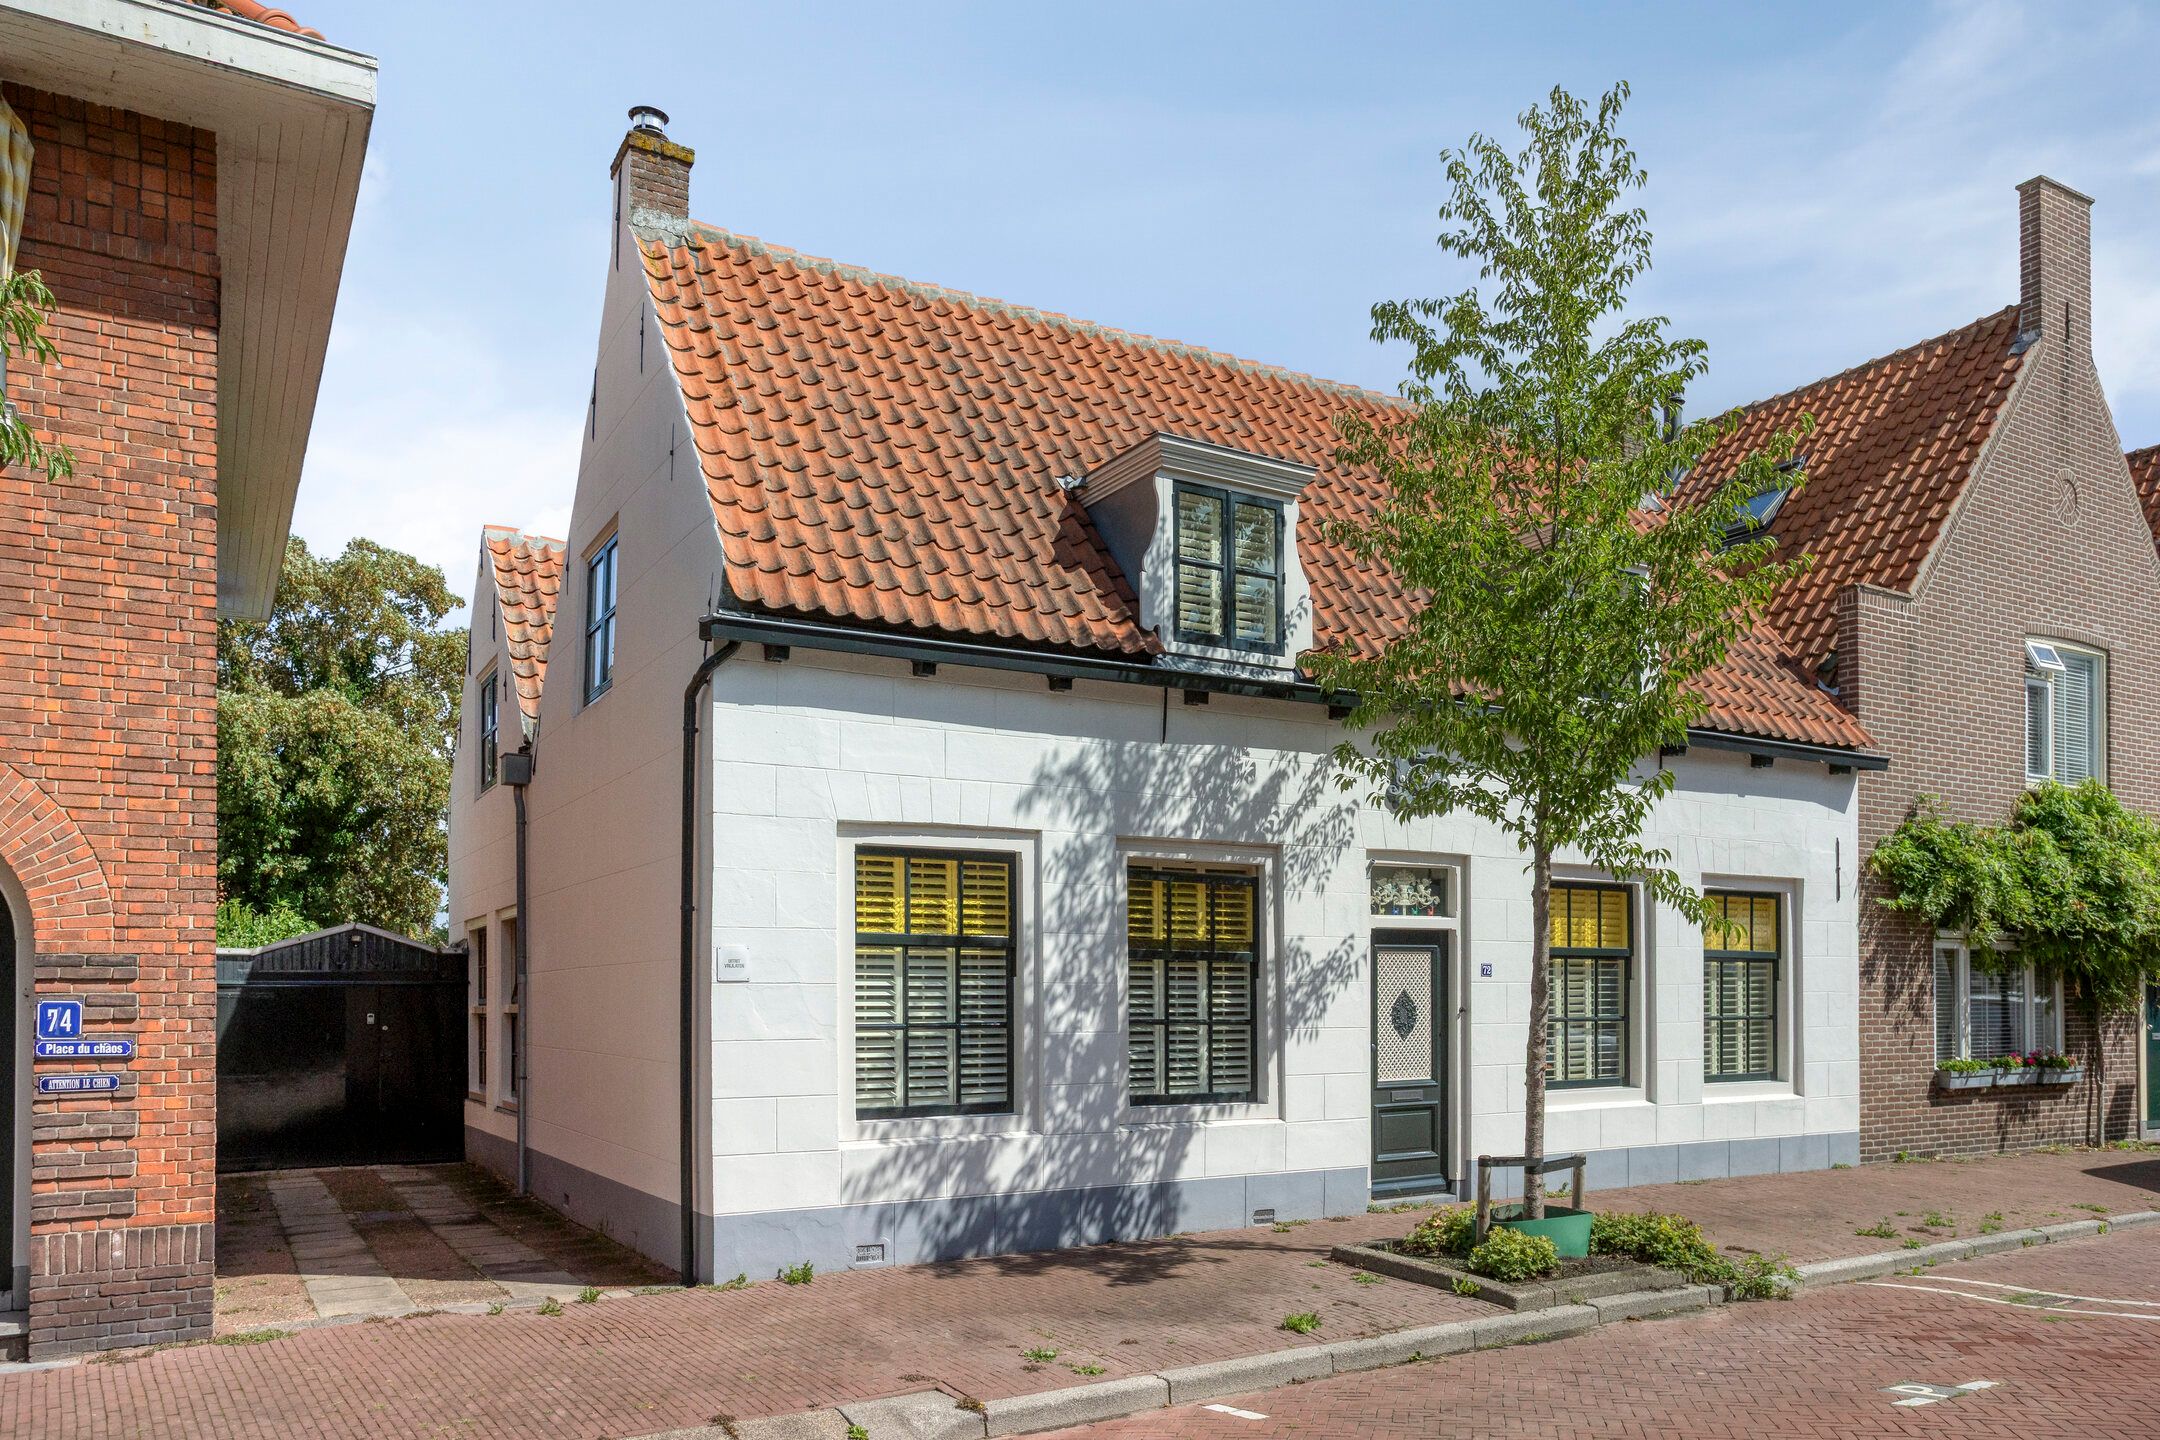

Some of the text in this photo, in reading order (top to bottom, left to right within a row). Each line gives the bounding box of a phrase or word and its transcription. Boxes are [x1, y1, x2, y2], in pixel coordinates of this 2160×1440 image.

[1482, 966, 1492, 975] 72
[47, 1008, 72, 1032] 74
[46, 1044, 74, 1054] Place
[78, 1044, 90, 1054] du
[48, 1078, 111, 1090] ATTENTION LE CHIEN
